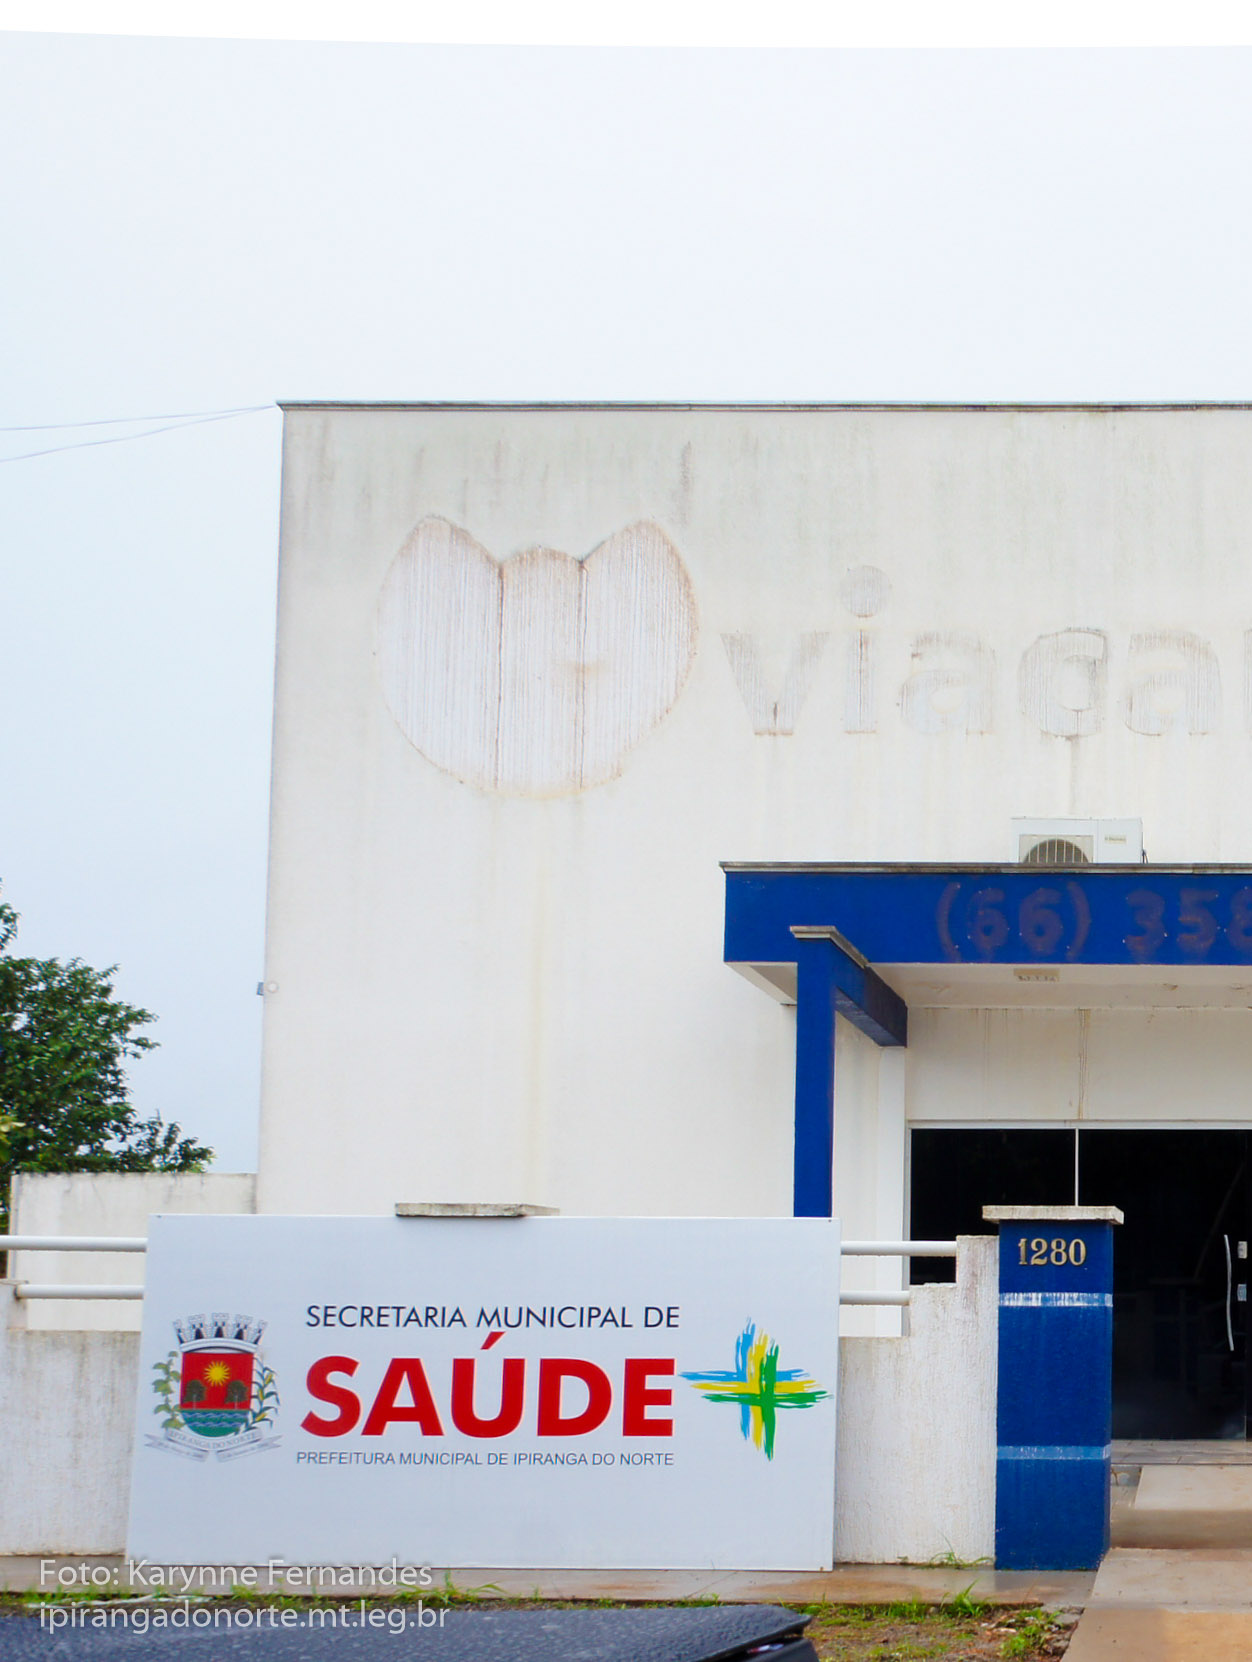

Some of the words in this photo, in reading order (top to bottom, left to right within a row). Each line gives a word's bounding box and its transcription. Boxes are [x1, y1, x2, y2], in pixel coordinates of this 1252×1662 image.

[936, 881, 1090, 961] (66)
[1018, 1238, 1086, 1266] 1280
[305, 1305, 467, 1328] SECRETARIA
[475, 1306, 634, 1328] MUNICIPAL
[643, 1306, 680, 1328] DE
[300, 1331, 675, 1439] SAÚDE
[296, 1452, 395, 1465] PREFEITURA
[399, 1452, 483, 1466] MUNICIPAL
[487, 1453, 509, 1465] DE
[513, 1453, 588, 1466] IPIRANGA
[592, 1453, 616, 1466] DO
[619, 1453, 675, 1466] NORTE
